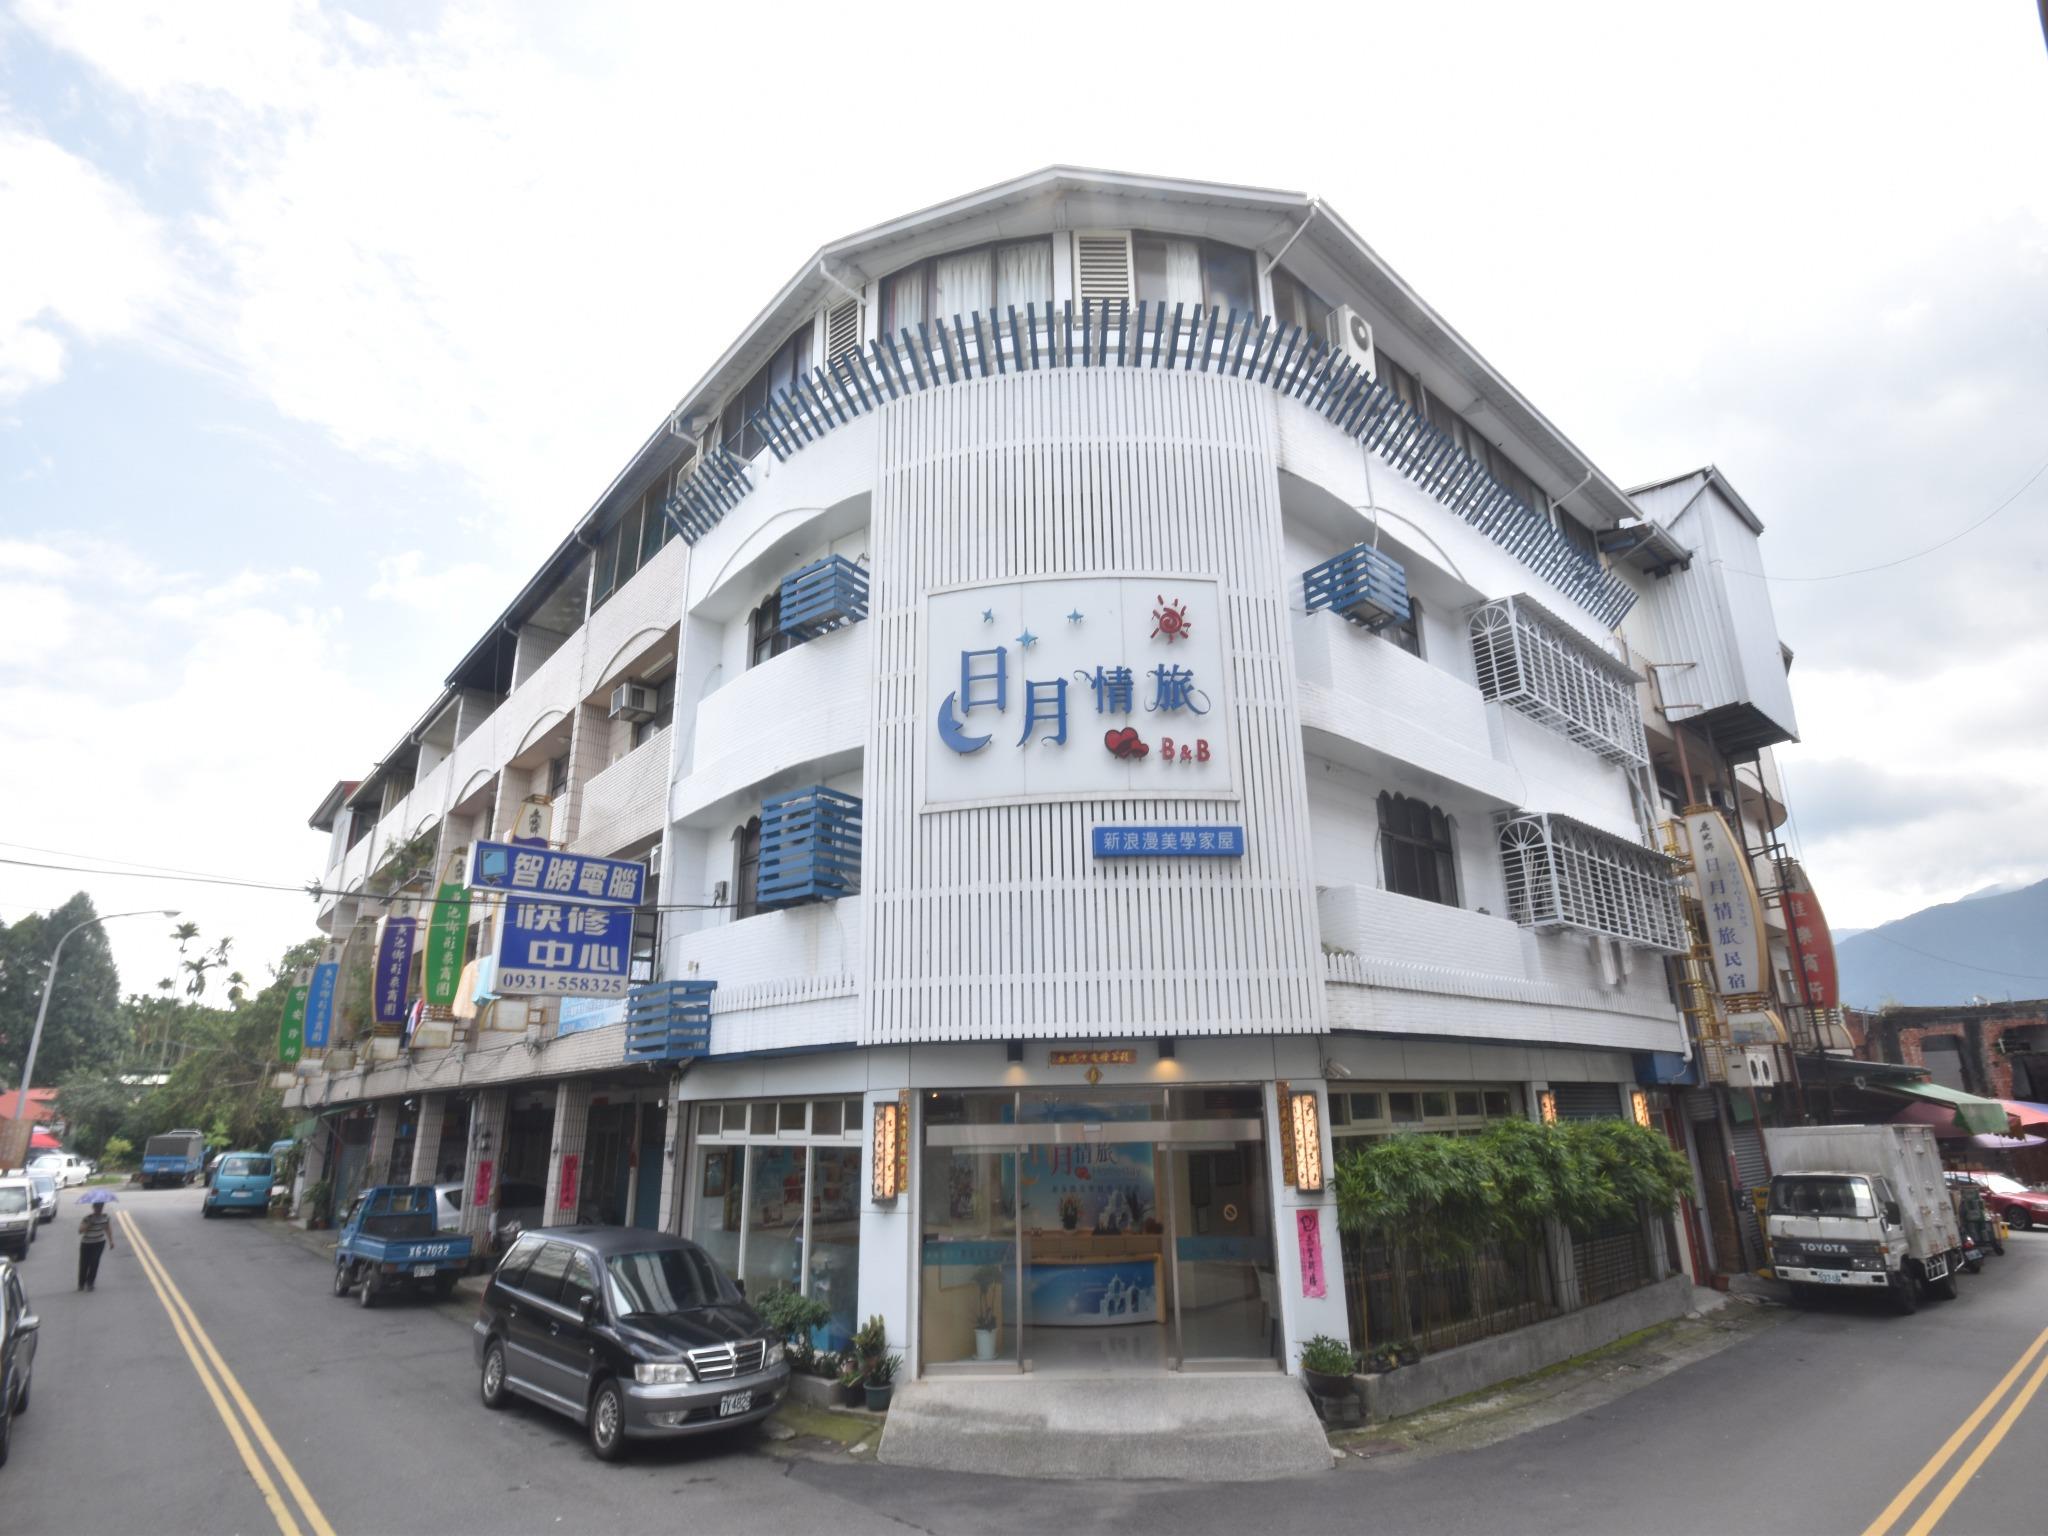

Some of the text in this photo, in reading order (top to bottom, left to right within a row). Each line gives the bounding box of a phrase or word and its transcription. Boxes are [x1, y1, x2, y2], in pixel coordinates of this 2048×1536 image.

[960, 645, 1211, 749] 日月情旅
[1161, 737, 1211, 762] B&B
[1103, 830, 1235, 851] 新浪漫美學家屋
[511, 853, 639, 900] 智勝電腦
[515, 904, 610, 936] 快修
[1705, 857, 1746, 990] 日月情旅民宿
[527, 940, 620, 972] 中心
[502, 972, 622, 994] 0931-558325
[1799, 1242, 1849, 1254] TOYOTA
